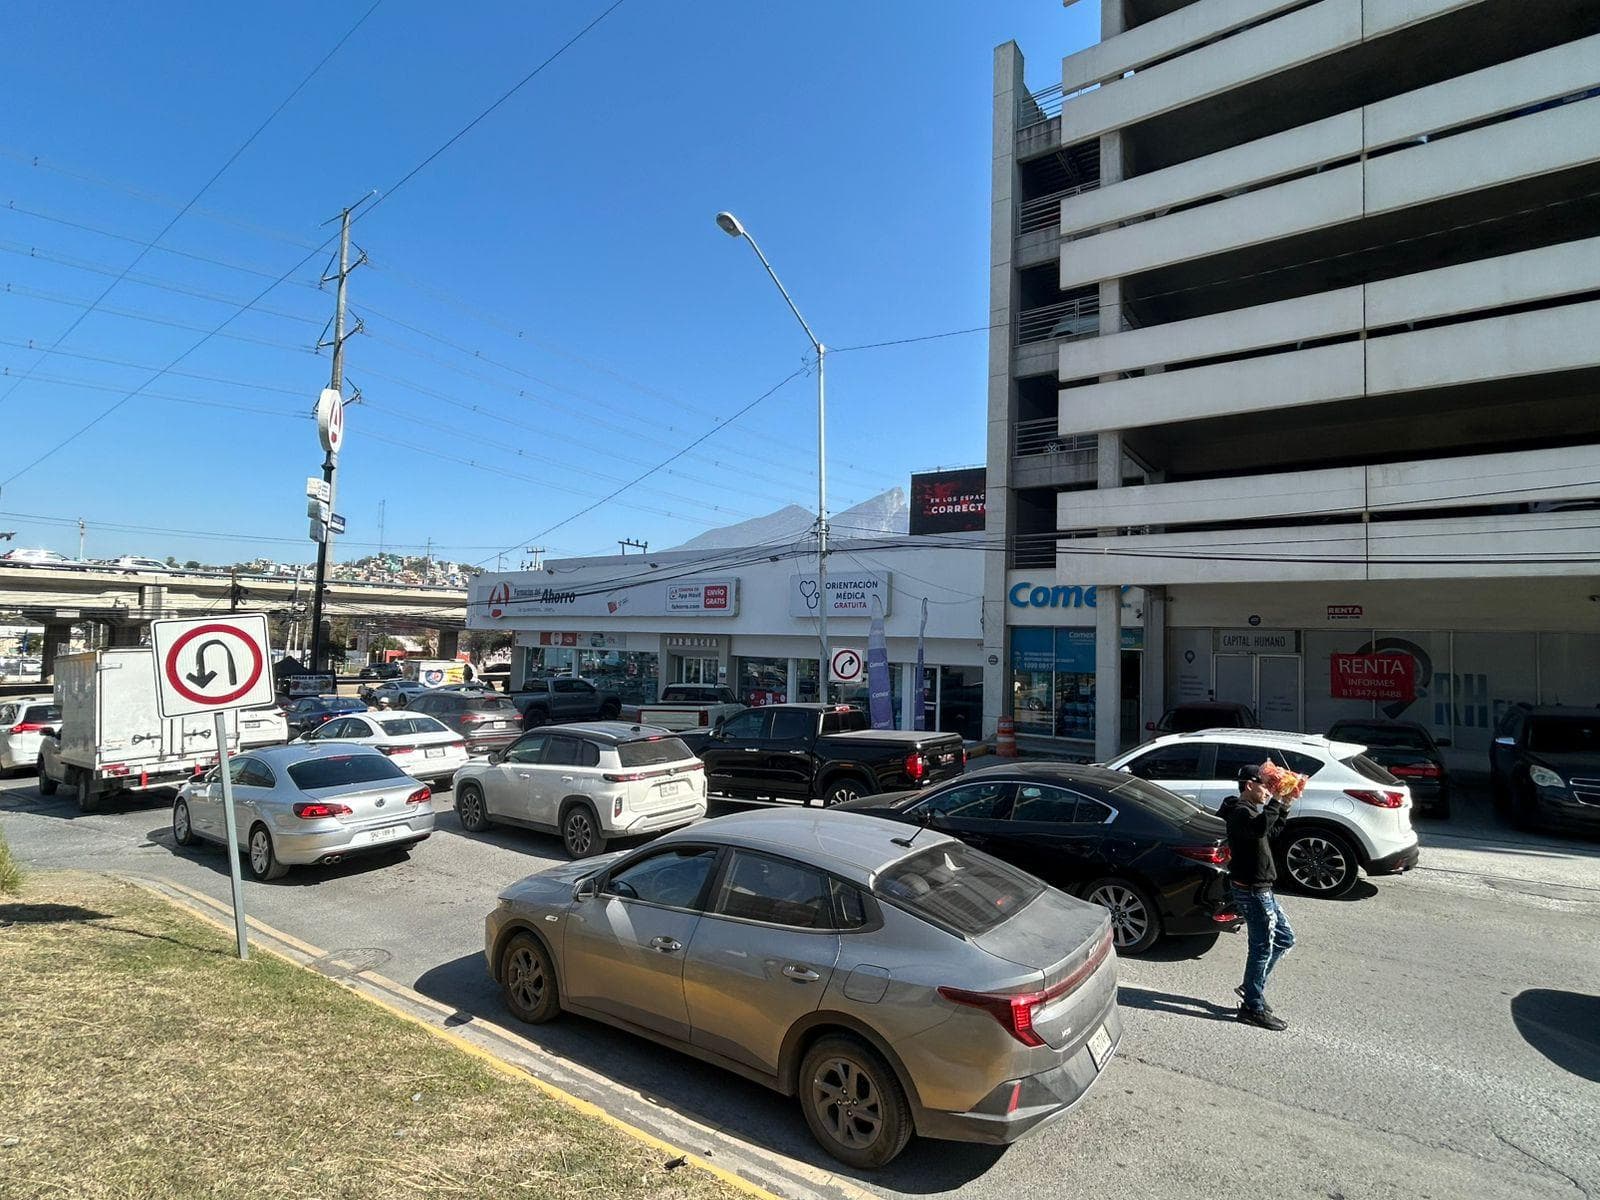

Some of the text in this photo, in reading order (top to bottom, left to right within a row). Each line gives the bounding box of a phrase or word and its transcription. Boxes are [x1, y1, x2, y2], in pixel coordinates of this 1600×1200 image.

[931, 503, 986, 514] CORRECT
[825, 579, 879, 590] ORIENTACIÓN
[541, 588, 576, 604] Ahorro
[706, 587, 724, 596] ENVÍO
[836, 591, 866, 600] MÉDICA
[1327, 607, 1361, 615] RENTA
[666, 637, 718, 648] FARMACIA
[1223, 635, 1286, 648] CAPITAL HUMANO
[1338, 659, 1406, 675] RENTA
[1348, 678, 1396, 687] INFORMES
